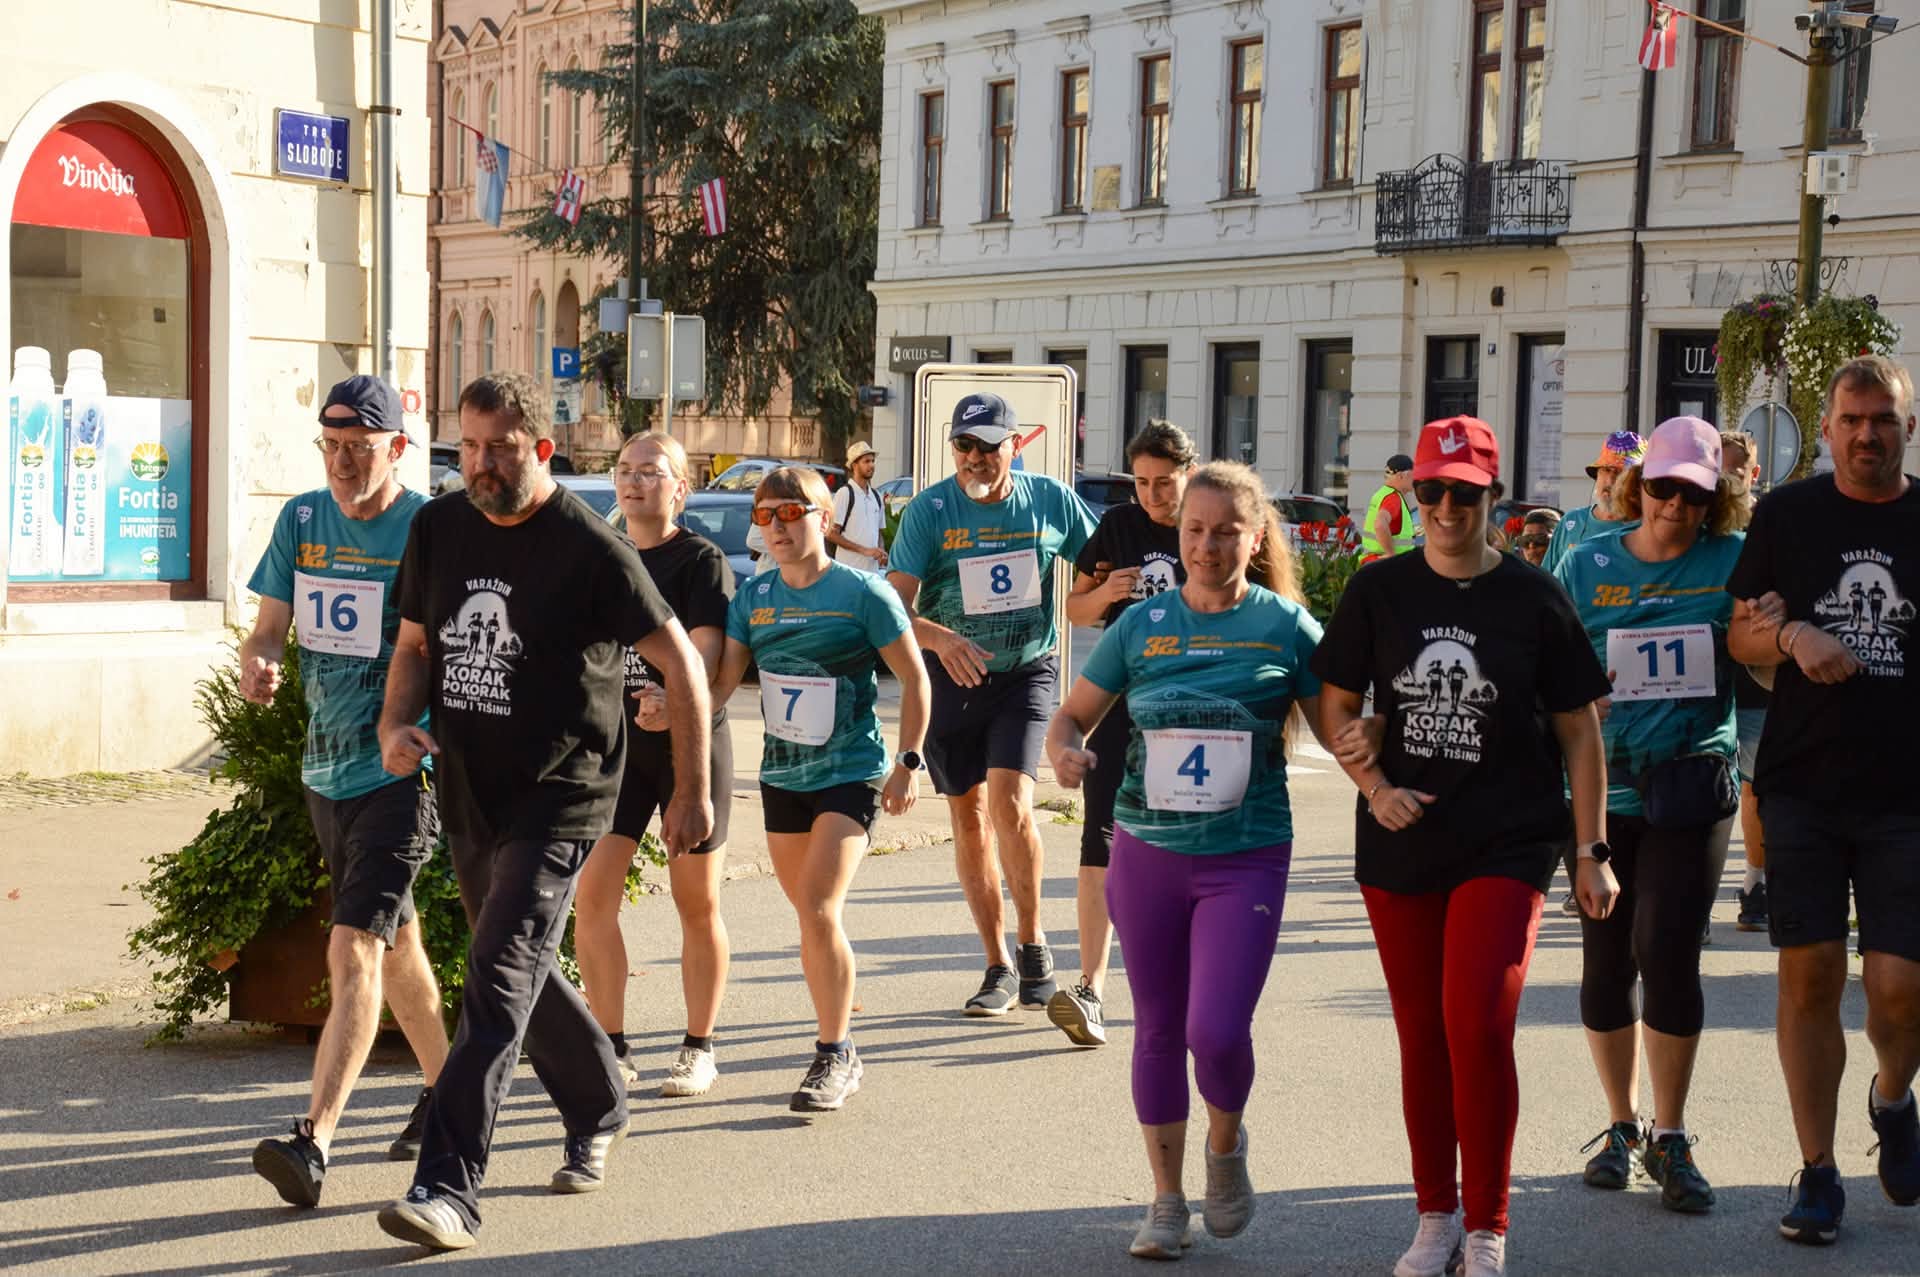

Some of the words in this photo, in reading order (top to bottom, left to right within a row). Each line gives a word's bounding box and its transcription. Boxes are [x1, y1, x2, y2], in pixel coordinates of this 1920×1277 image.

[303, 124, 327, 138] TRG
[287, 142, 342, 169] SLOBODE
[58, 155, 134, 196] Vindija
[560, 353, 573, 372] P
[20, 472, 33, 537] Fortia
[73, 472, 86, 537] Fortia
[118, 486, 178, 509] Fortia
[119, 525, 177, 538] IMUNITETA
[1841, 548, 1893, 566] VARAŽDIN
[465, 577, 513, 597] VARAŽDIN
[990, 564, 1013, 594] 8
[307, 590, 358, 632] 16
[1421, 625, 1477, 647] VARAŽDIN
[1839, 633, 1898, 650] ORAK
[1636, 638, 1685, 677] 11
[446, 664, 506, 688] KORAK
[461, 682, 511, 701] KORAK
[442, 696, 467, 710] TAMU
[469, 702, 473, 711] I
[477, 702, 511, 716] TIŠINU
[781, 688, 803, 721] 7
[1406, 712, 1478, 734] KORAK
[1403, 726, 1425, 741] PO
[1426, 730, 1482, 747] KORAK
[1403, 742, 1433, 758] TAMU
[1443, 748, 1481, 763] TIŠINU
[1177, 744, 1210, 786] 4
